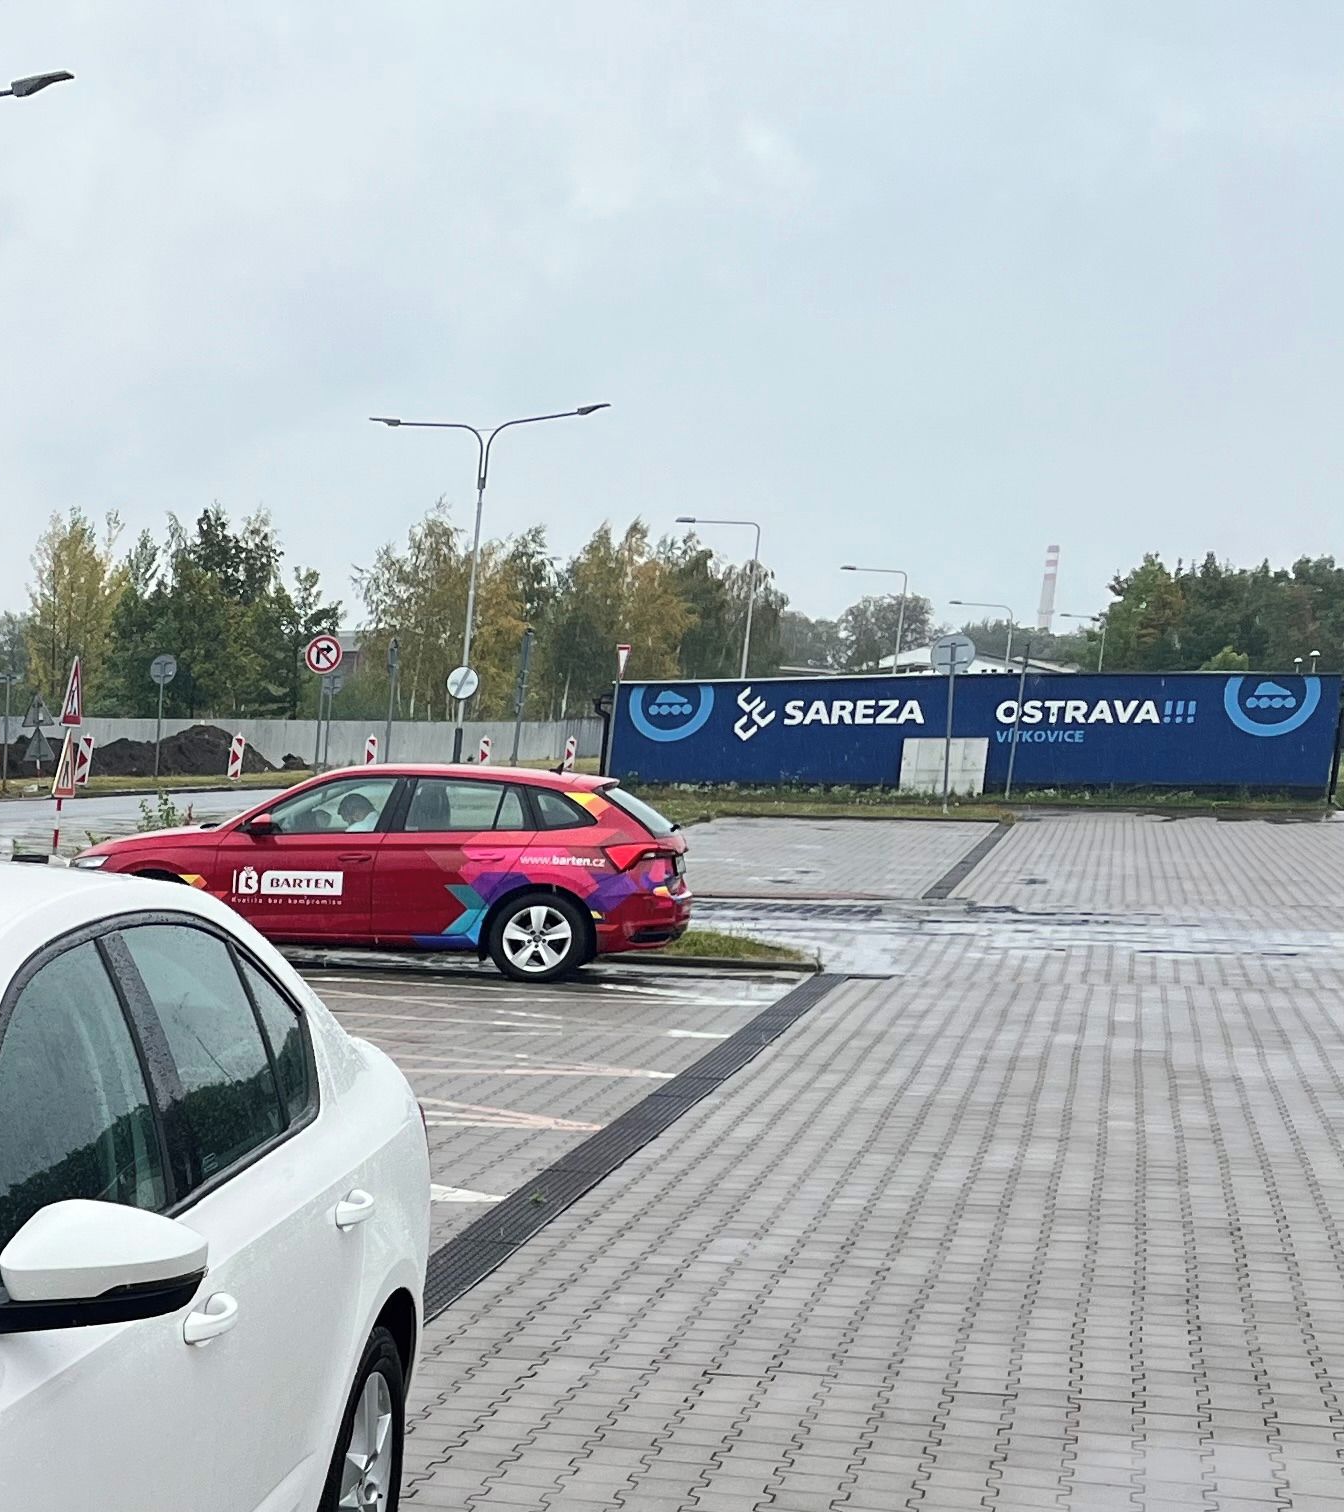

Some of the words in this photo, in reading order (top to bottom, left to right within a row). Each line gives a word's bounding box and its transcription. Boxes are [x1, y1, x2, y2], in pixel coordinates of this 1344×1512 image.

[783, 699, 925, 726] SAREZA
[996, 728, 1085, 744] VÍTKOVICE
[519, 855, 606, 868] www.barten.cz
[270, 878, 334, 888] BARTEN
